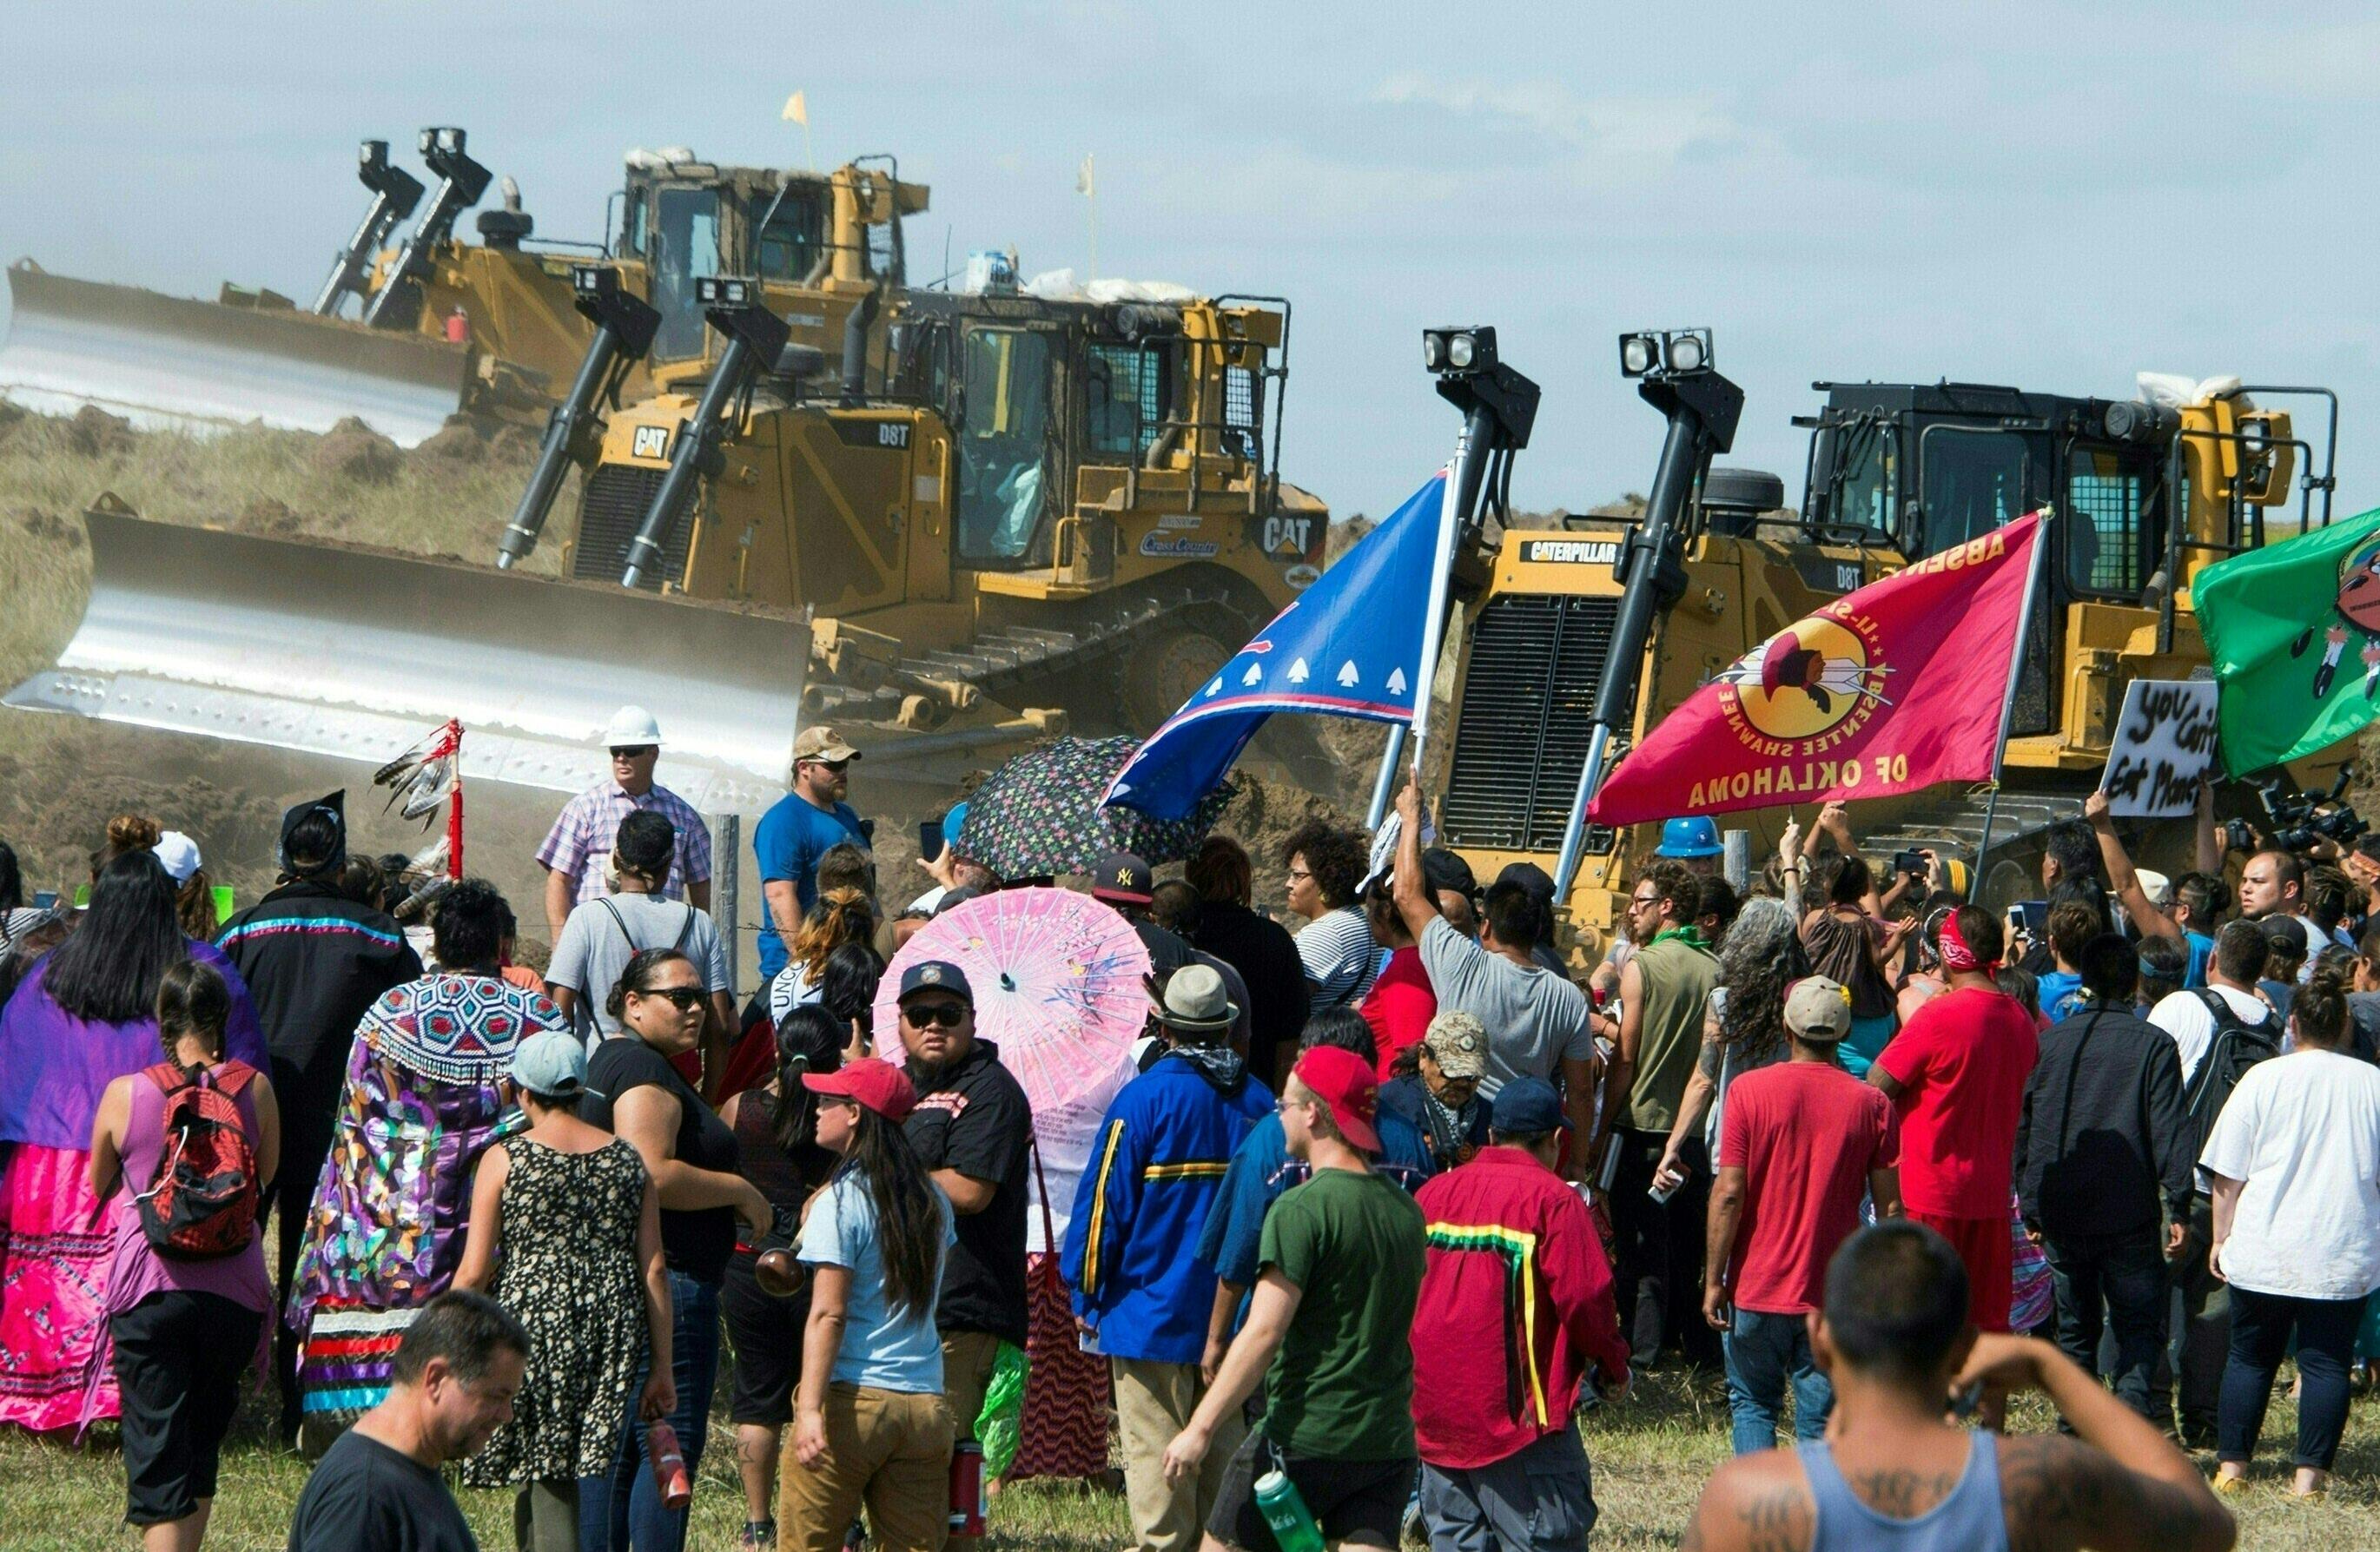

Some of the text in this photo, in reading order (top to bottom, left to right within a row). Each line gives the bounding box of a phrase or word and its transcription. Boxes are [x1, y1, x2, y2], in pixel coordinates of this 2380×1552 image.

[634, 427, 667, 458] CAT
[879, 424, 909, 447] D8T
[1264, 517, 1311, 555] CAT
[1530, 541, 1616, 563] CATERPILLAR
[1836, 565, 1861, 591] D8T
[1116, 868, 1134, 886] NY
